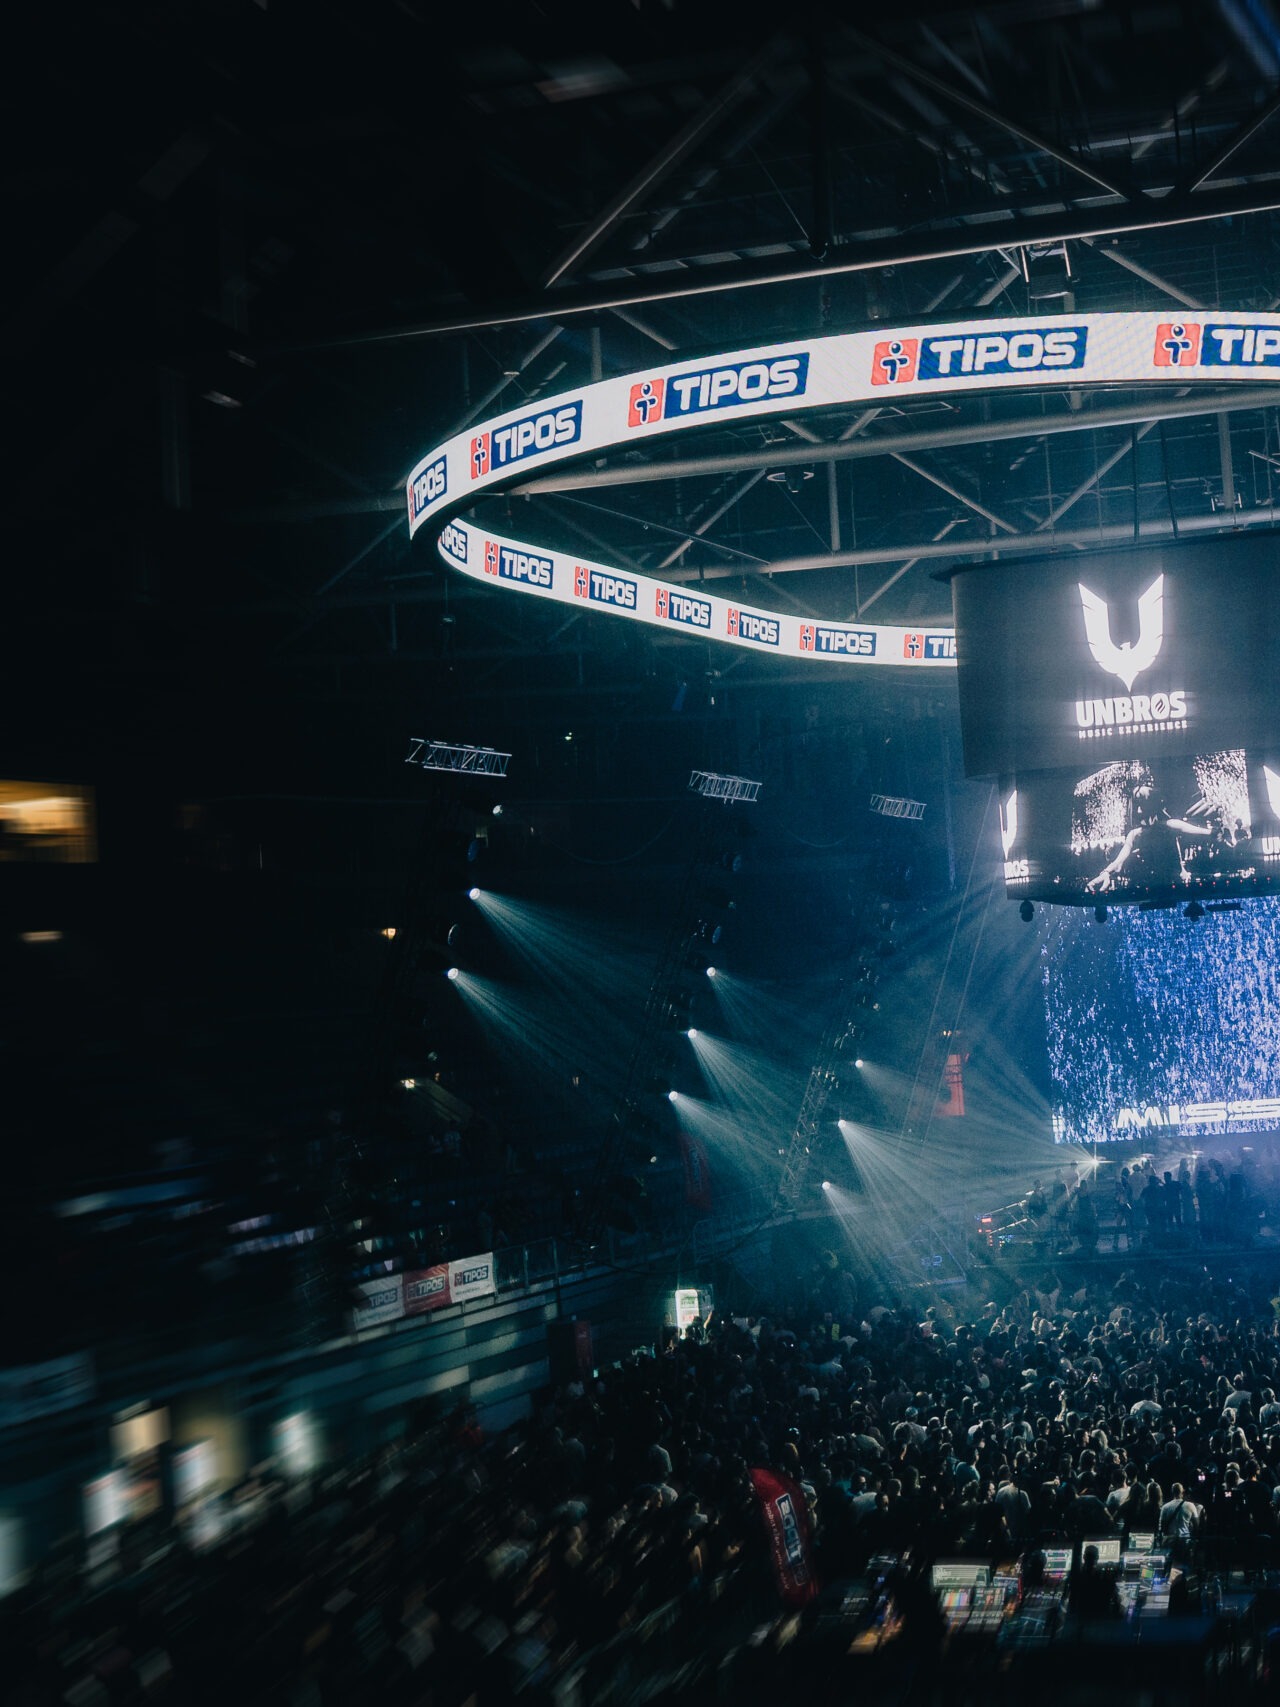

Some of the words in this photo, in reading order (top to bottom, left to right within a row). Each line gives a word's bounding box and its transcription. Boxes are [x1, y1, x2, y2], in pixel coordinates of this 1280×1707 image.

[929, 332, 1078, 375] TIPOS
[673, 358, 800, 411] TIPOS
[495, 407, 577, 462] TIPOS
[413, 461, 445, 512] TIPOS
[502, 551, 552, 585] TIPOS
[590, 574, 636, 607] TIPOS
[671, 596, 711, 626] TIPOS
[740, 614, 778, 643] TIPOS
[819, 631, 873, 655] TIPOS
[928, 637, 956, 657] TIP
[1075, 691, 1188, 727] UNBROS
[1078, 727, 1113, 739] MUSIC
[1118, 720, 1188, 735] EXPERIENCE
[418, 1278, 444, 1295] TIPOS
[463, 1267, 488, 1284] TIPOS
[369, 1290, 397, 1309] TIPOS
